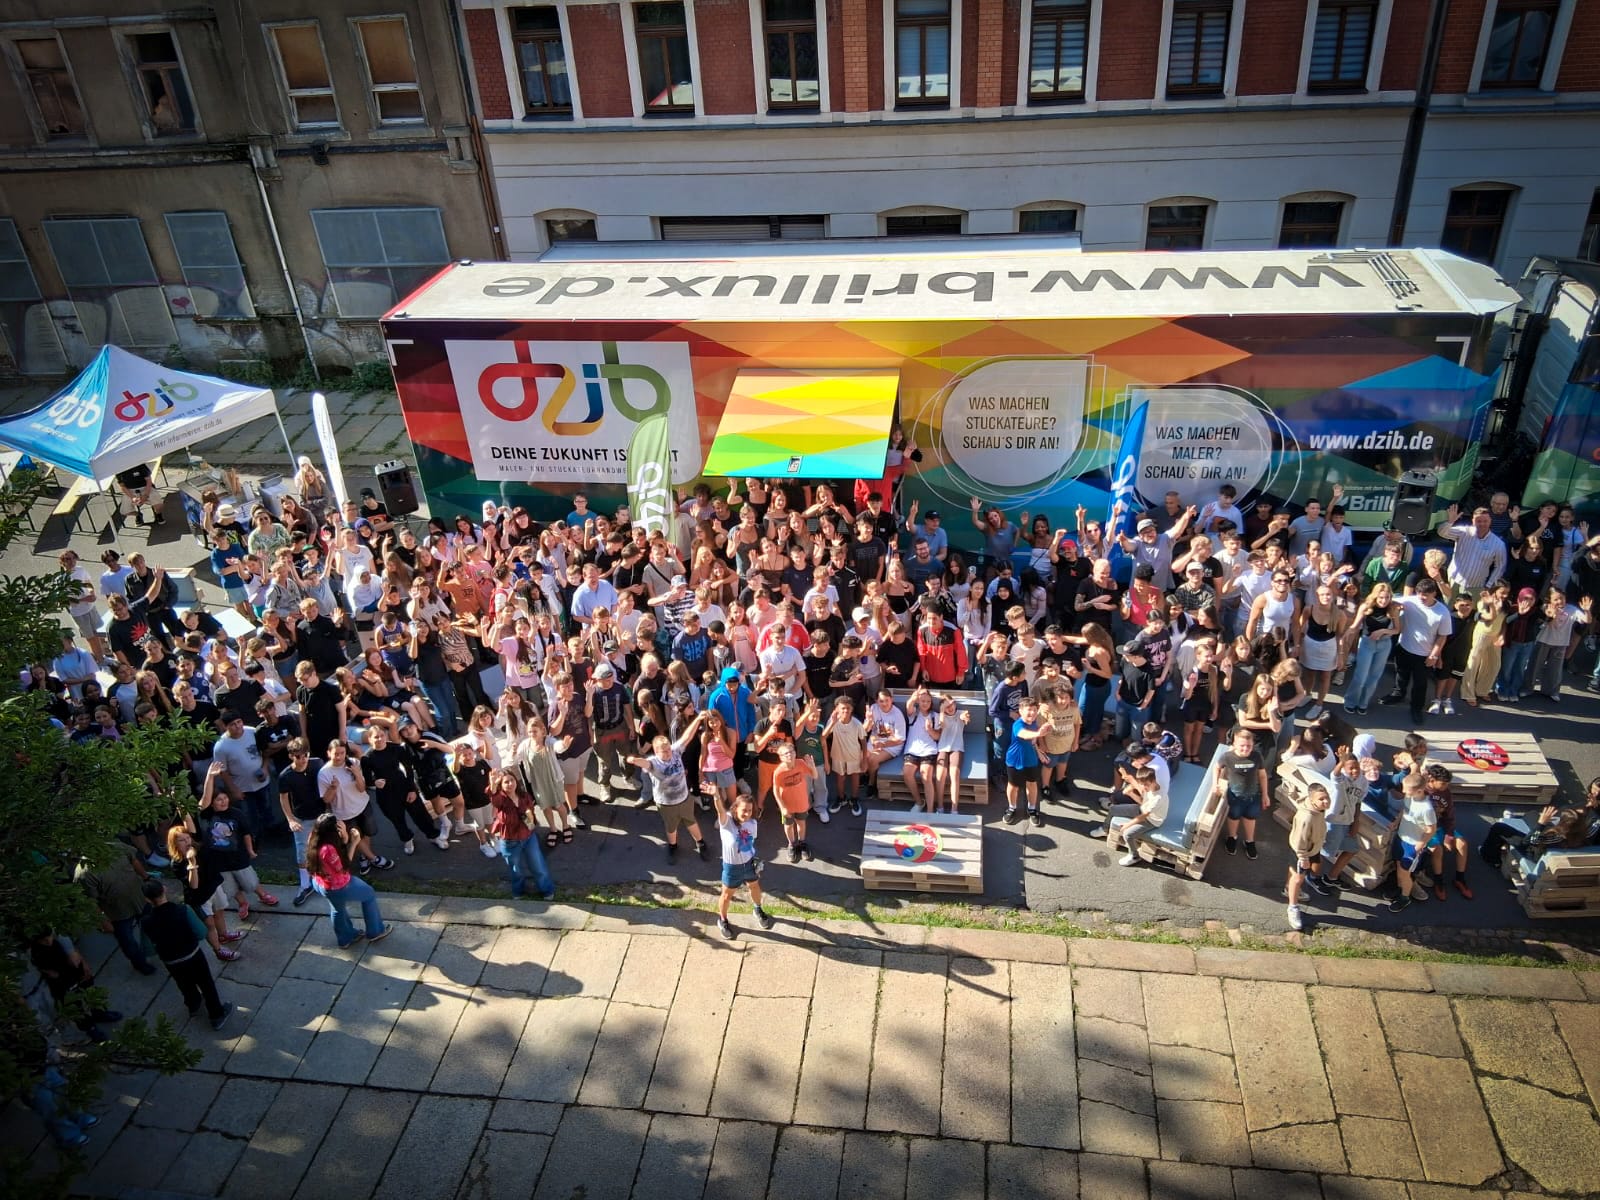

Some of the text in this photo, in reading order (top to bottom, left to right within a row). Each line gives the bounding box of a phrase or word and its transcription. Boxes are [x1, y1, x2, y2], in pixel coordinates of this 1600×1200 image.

[482, 266, 1364, 304] www.brillux.de
[968, 396, 1049, 410] WAS MACHEN
[966, 416, 1057, 430] STUCKATEURE?
[1155, 426, 1240, 440] WAS MACHEN
[1309, 430, 1434, 450] www.dzib.de
[1016, 436, 1036, 449] DIR
[1039, 436, 1060, 449] AN!
[491, 446, 628, 461] DEINE ZUKUNFT IS
[1172, 446, 1222, 459] MALER?
[1201, 466, 1221, 479] DIR
[1225, 466, 1247, 479] AN!
